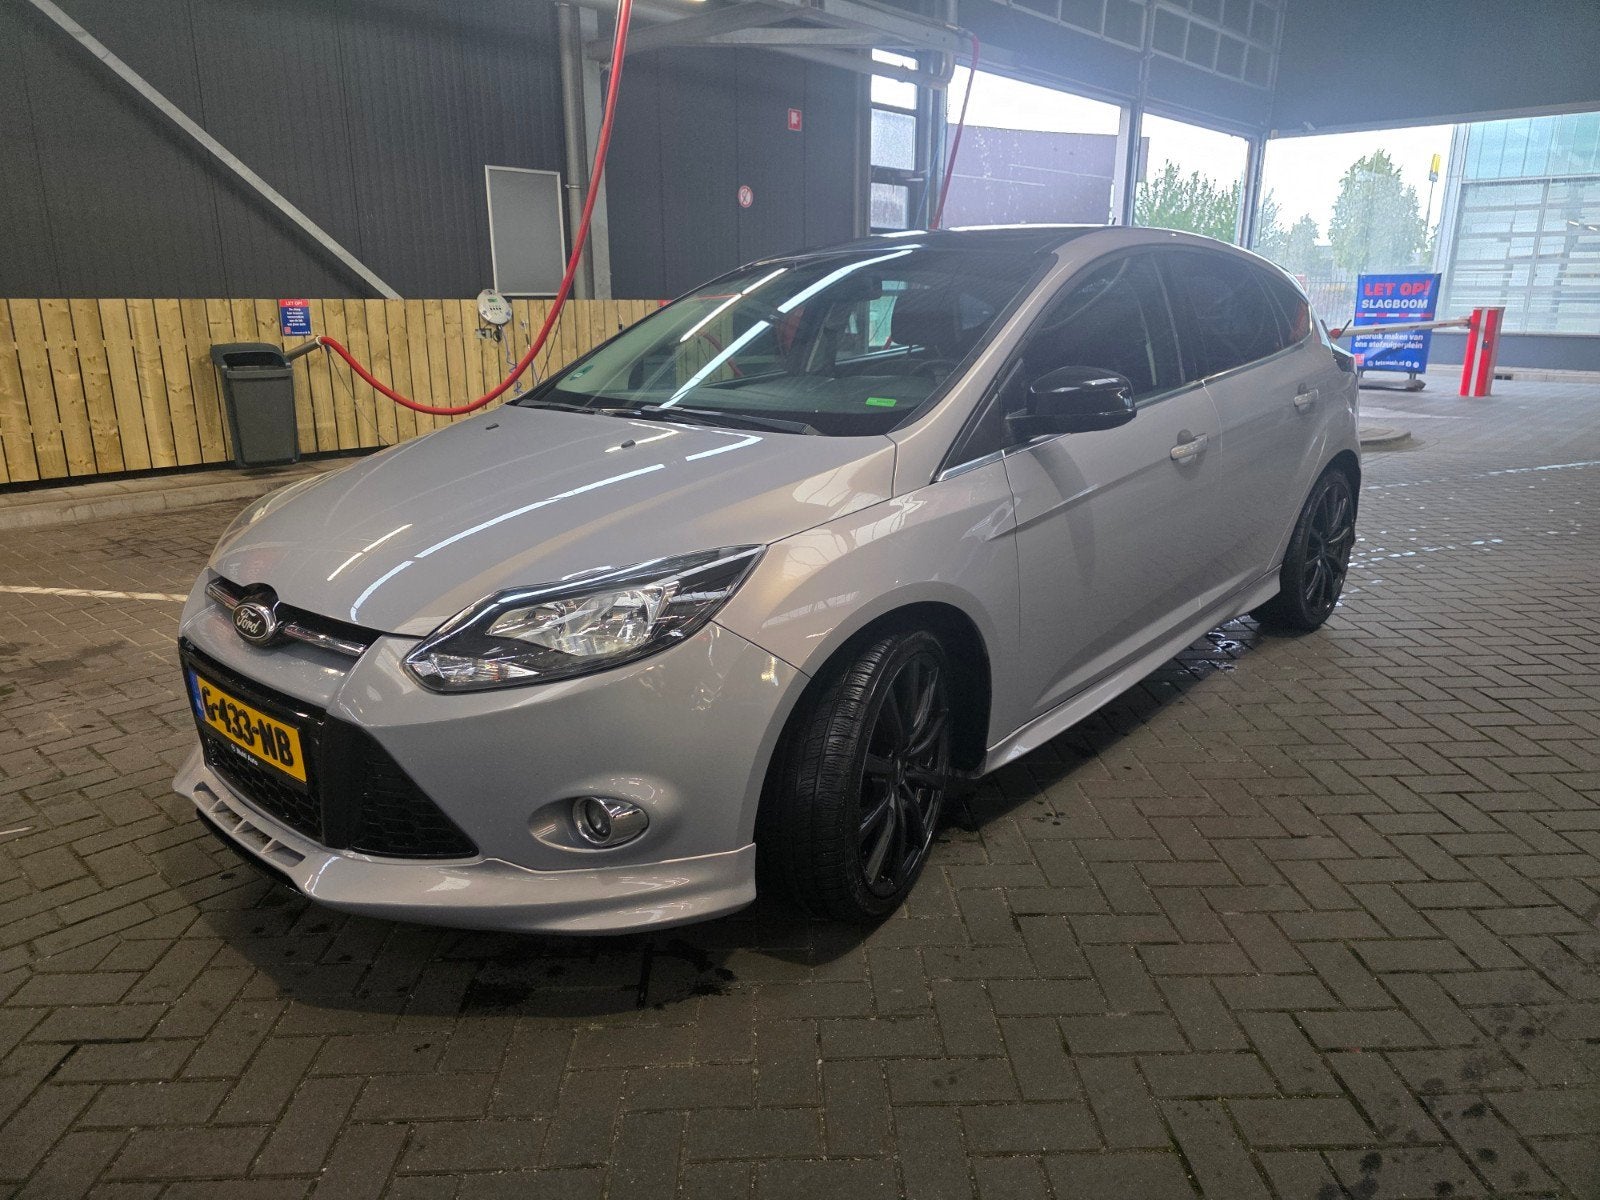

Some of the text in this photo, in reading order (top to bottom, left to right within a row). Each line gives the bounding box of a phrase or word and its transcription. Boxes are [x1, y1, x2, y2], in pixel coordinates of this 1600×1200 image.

[1364, 280, 1431, 296] LET OP!
[1361, 299, 1428, 309] SLAGBOOM
[1383, 332, 1408, 340] maken
[1368, 340, 1423, 349] stofzuigerplein
[236, 608, 262, 634] Ford
[201, 685, 294, 767] G-433-NB
